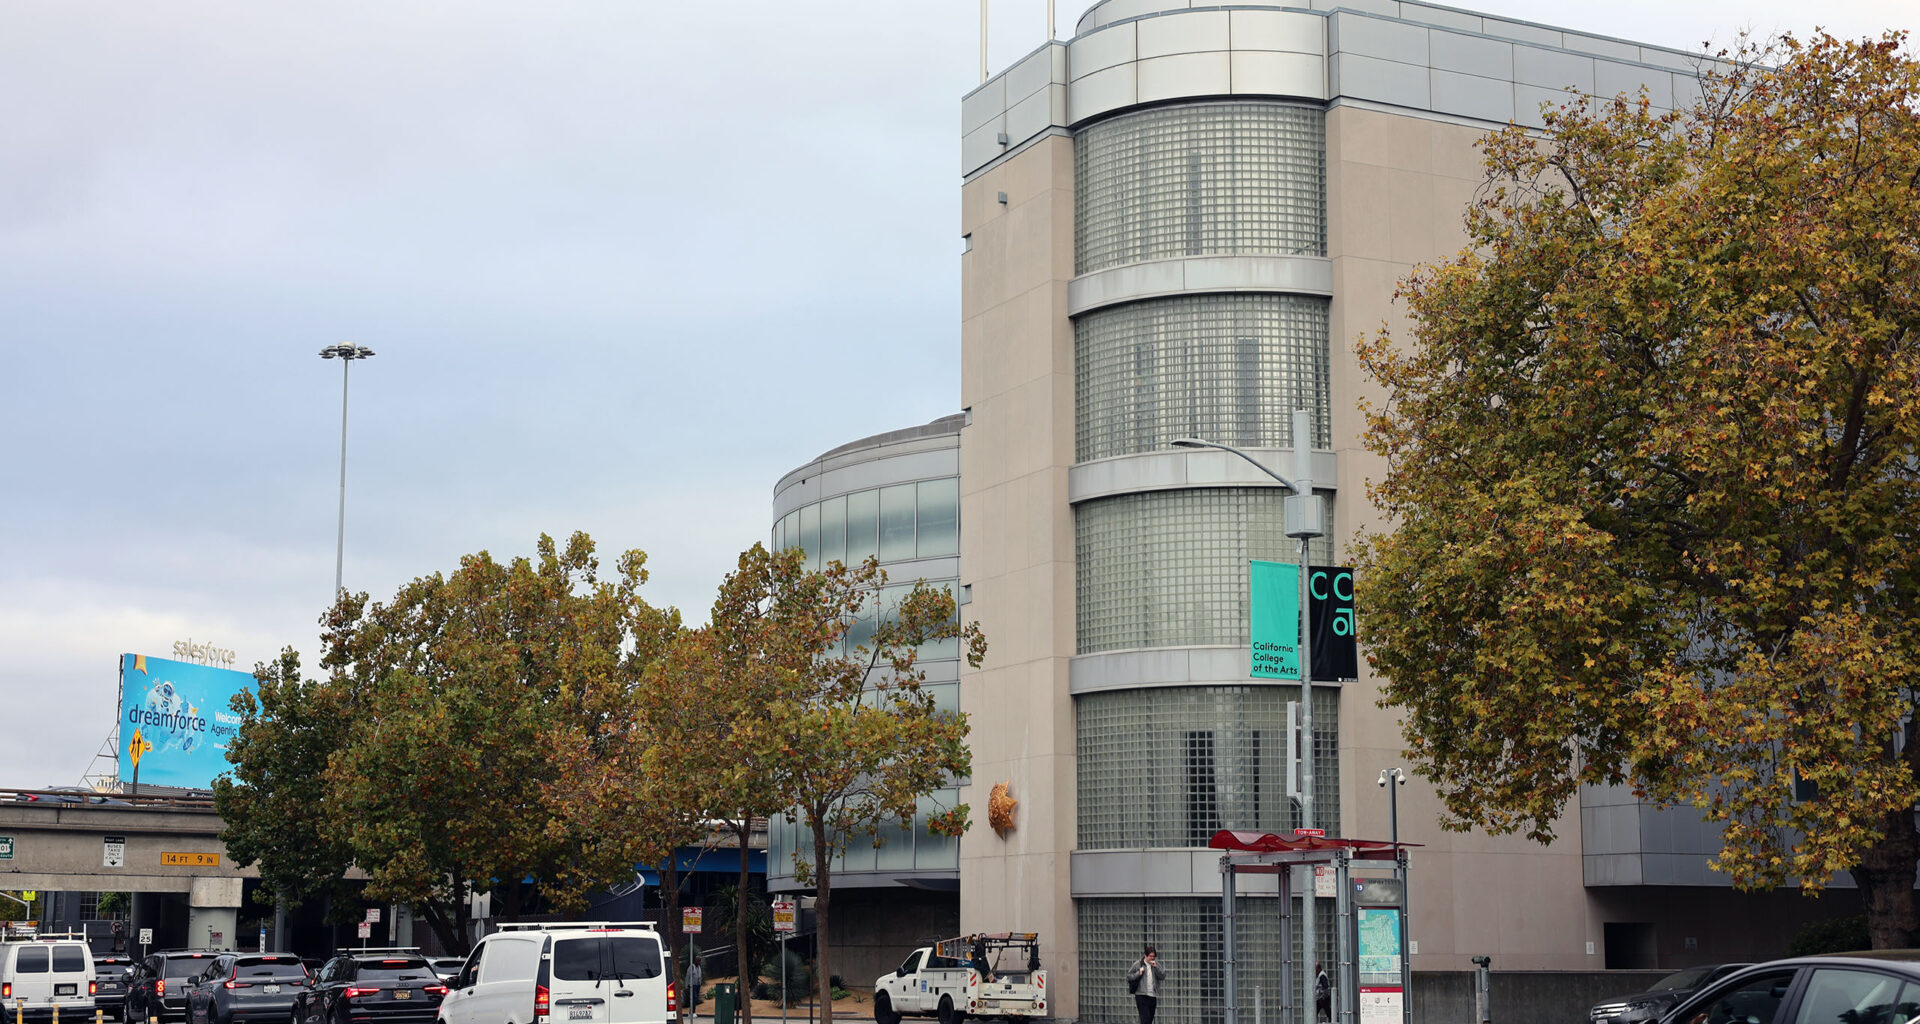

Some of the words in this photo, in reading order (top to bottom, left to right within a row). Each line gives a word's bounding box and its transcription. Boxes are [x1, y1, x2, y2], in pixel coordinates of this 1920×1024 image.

[173, 638, 235, 664] salesforce
[1253, 642, 1294, 653] California
[1253, 652, 1284, 665] College
[1253, 664, 1263, 672] of
[1264, 665, 1279, 673] the
[1280, 666, 1298, 675] Arts
[129, 704, 206, 734] dreamforce
[215, 711, 246, 725] Welcom
[210, 724, 237, 736] Agentic
[167, 854, 176, 863] 14
[197, 854, 203, 863] 9
